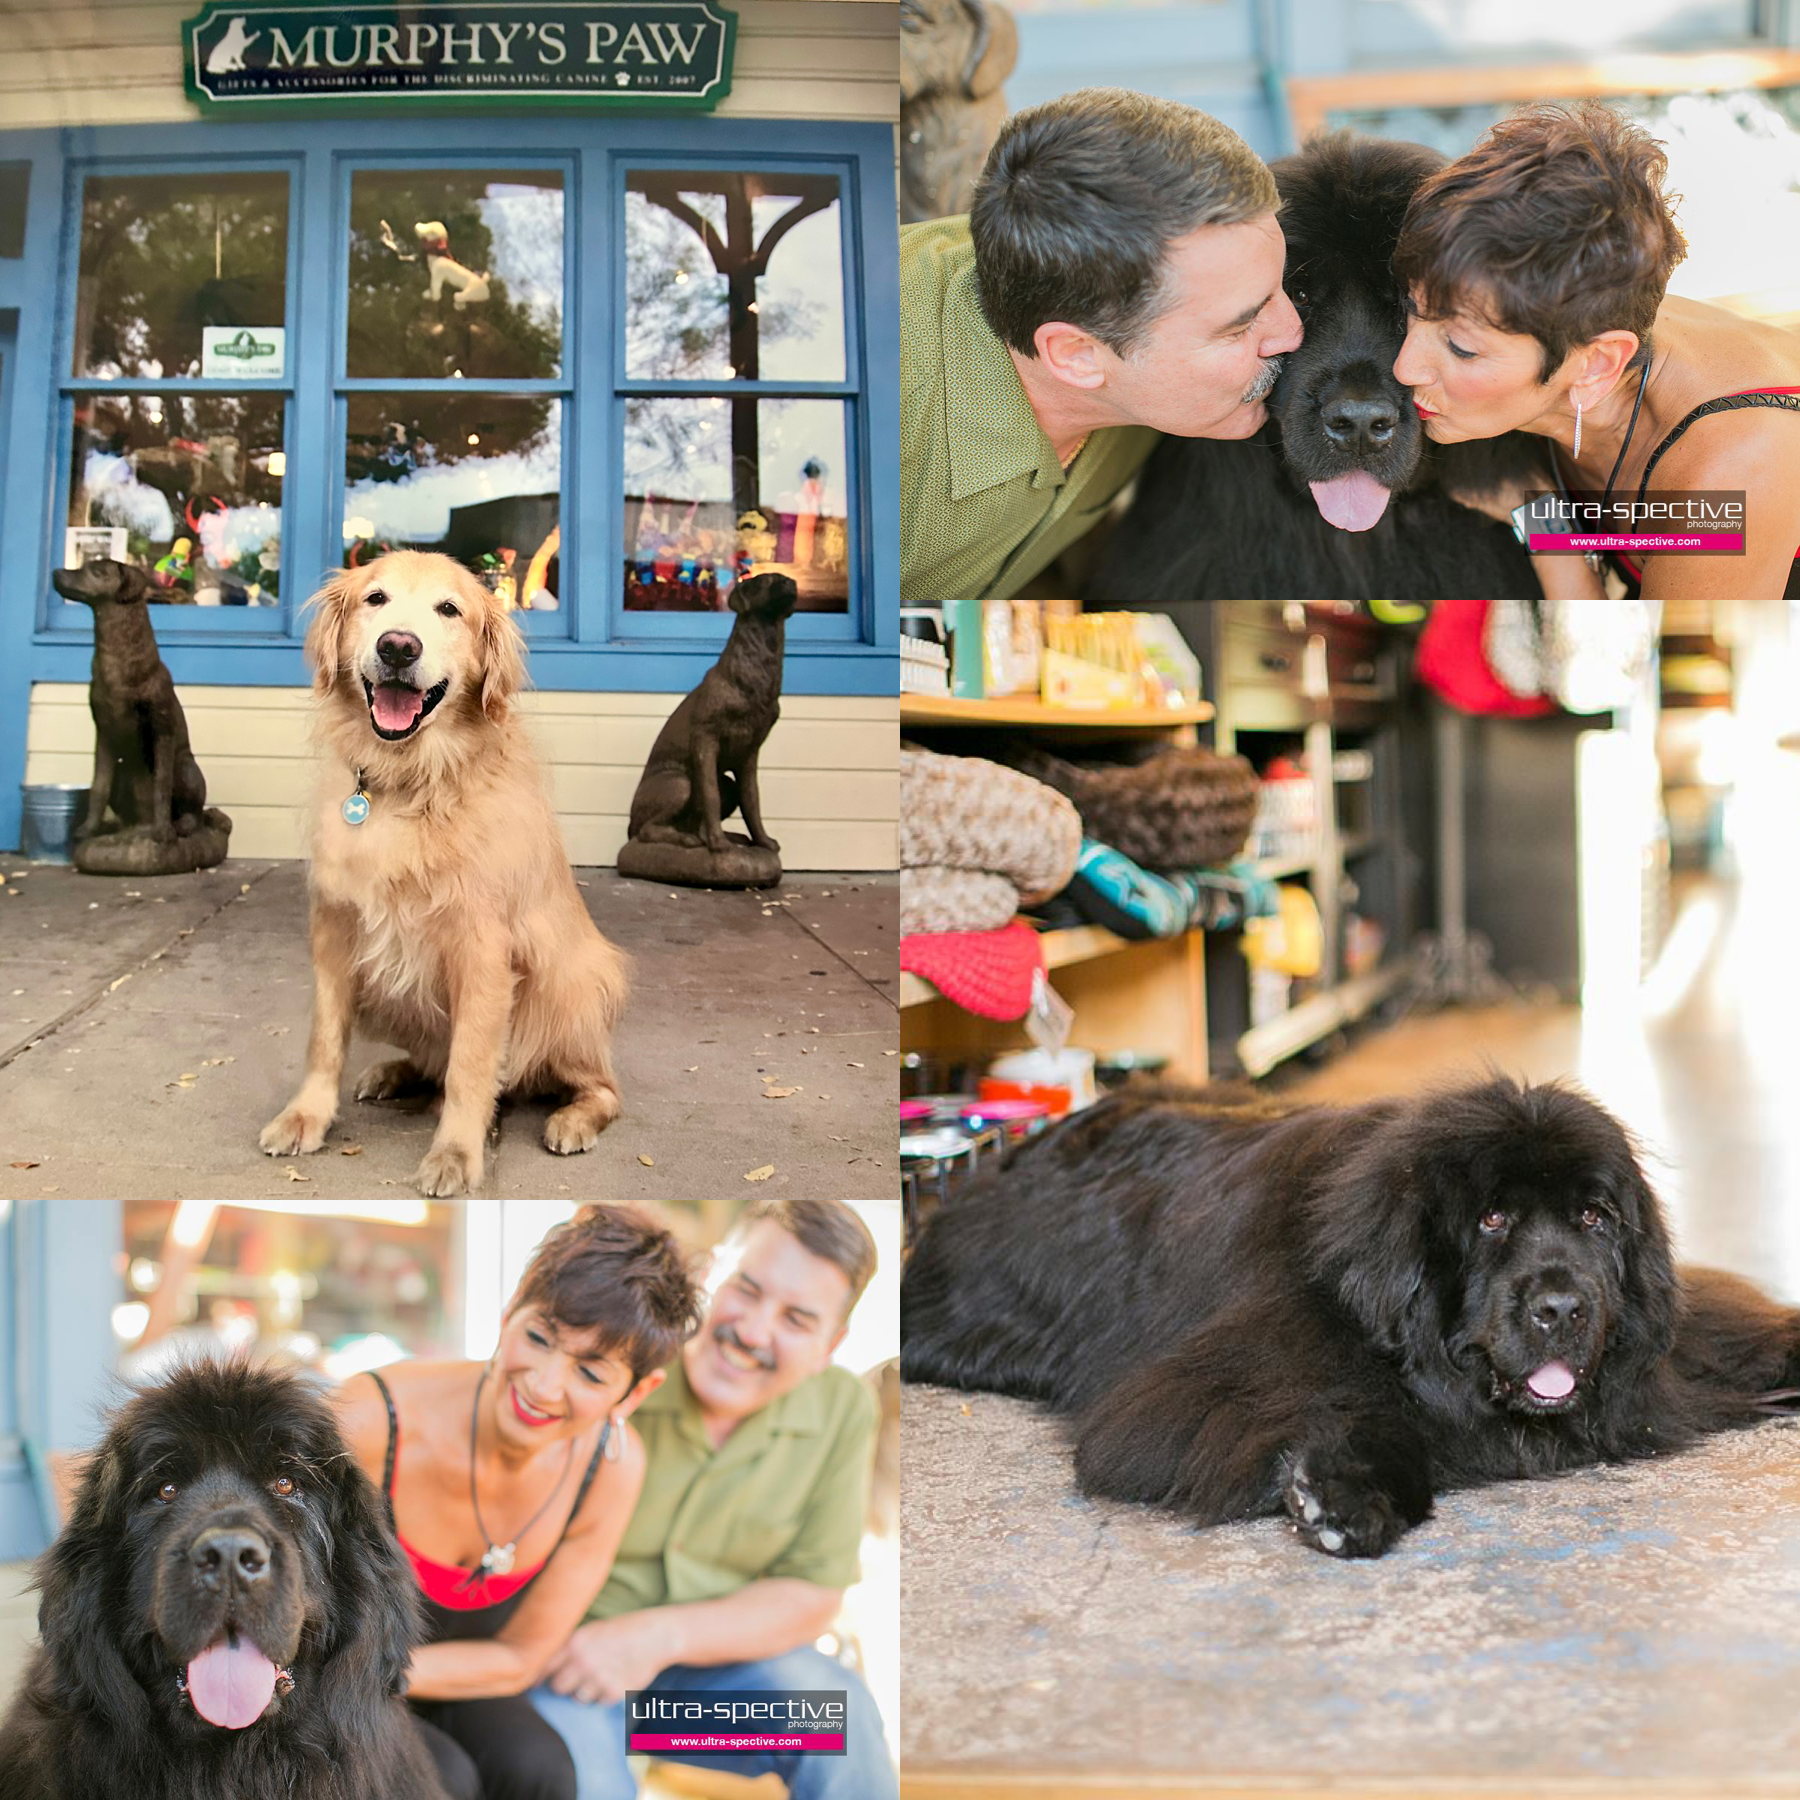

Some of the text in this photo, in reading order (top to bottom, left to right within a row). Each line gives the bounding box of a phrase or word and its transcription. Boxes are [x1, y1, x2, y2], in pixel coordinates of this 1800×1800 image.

[267, 22, 707, 67] MURPHY'S PAW
[371, 75, 398, 86] FOR
[404, 74, 428, 85] THE
[434, 73, 550, 85] DISCRIMINATING
[555, 74, 608, 84] CANINE
